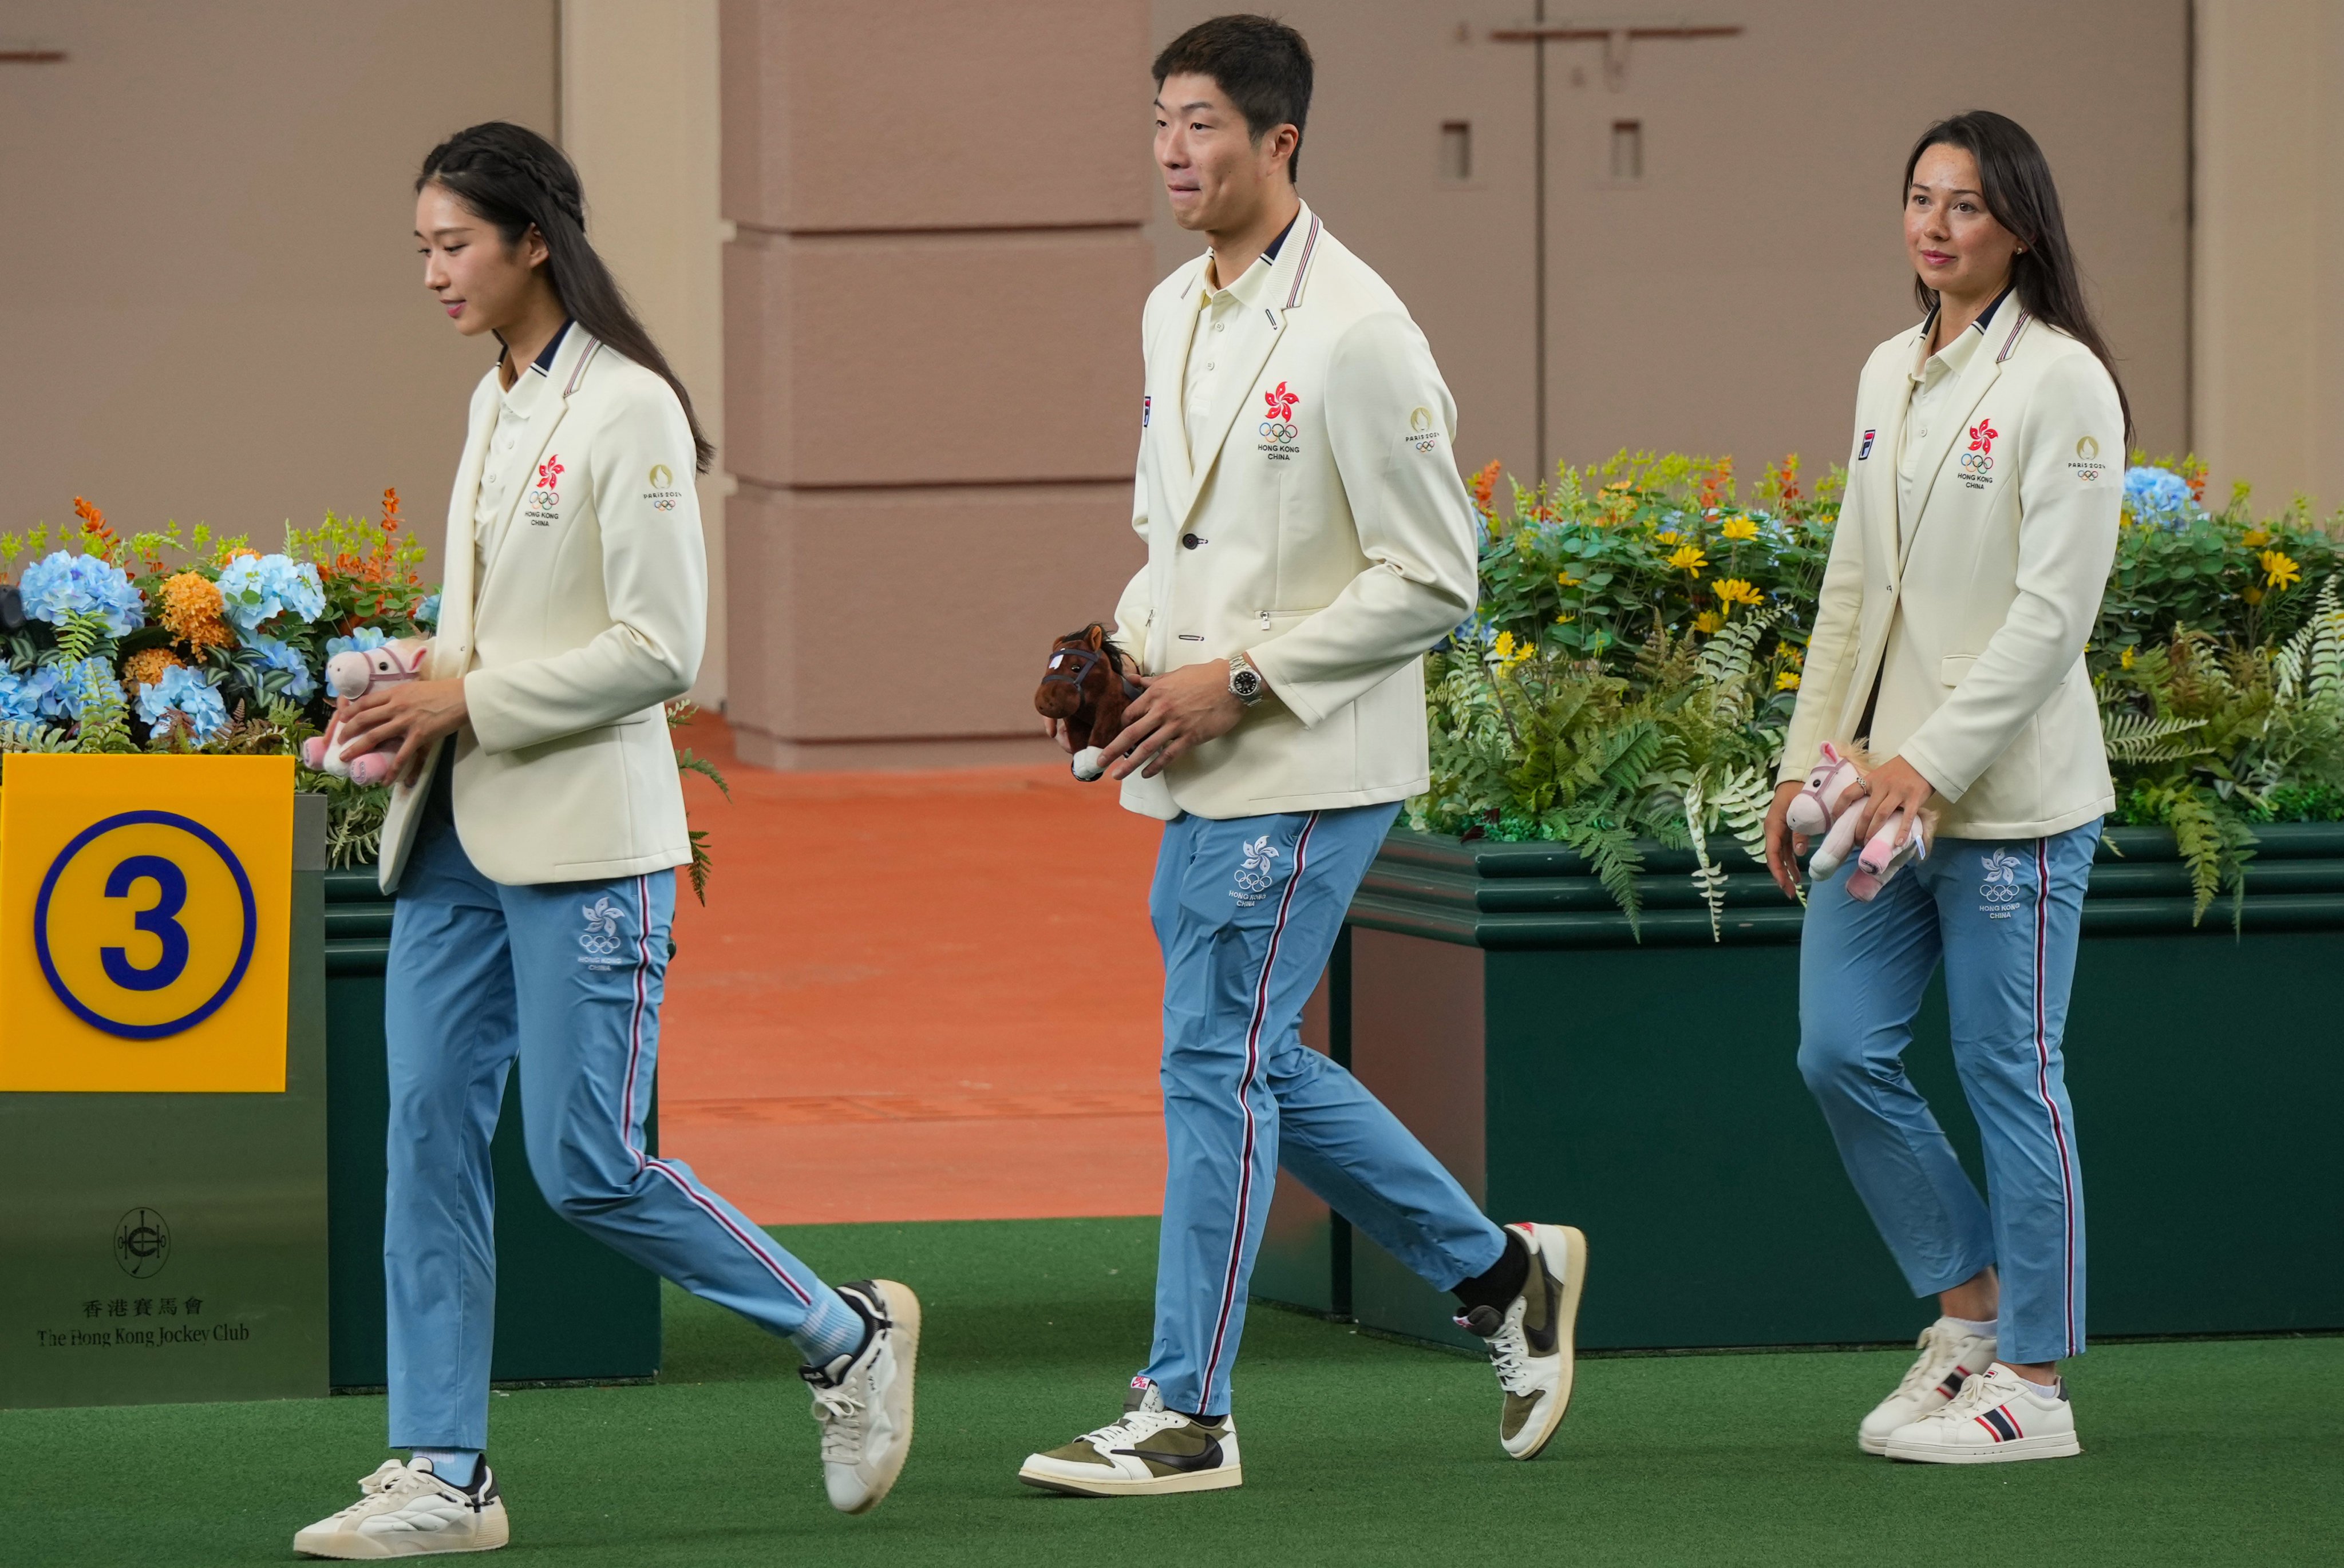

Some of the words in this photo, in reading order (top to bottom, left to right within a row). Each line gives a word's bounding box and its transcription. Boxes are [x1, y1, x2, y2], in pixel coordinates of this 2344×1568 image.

[1405, 434, 1424, 442] PARIS
[1258, 444, 1278, 452] HONG
[1280, 445, 1300, 453] KONG
[1957, 473, 1976, 481] HONG
[1977, 475, 1993, 484] KONG
[1966, 482, 1985, 490] CHINA
[531, 519, 550, 527] CHINA
[1228, 890, 1250, 900] HONG
[2001, 902, 2021, 911] KONG
[100, 854, 190, 992] 3
[82, 1296, 204, 1318] 香港賽馬會
[37, 1329, 67, 1347] The
[70, 1328, 111, 1348] Hong
[114, 1327, 155, 1348] Kong
[156, 1324, 210, 1348] Jockey
[212, 1323, 250, 1341] Club
